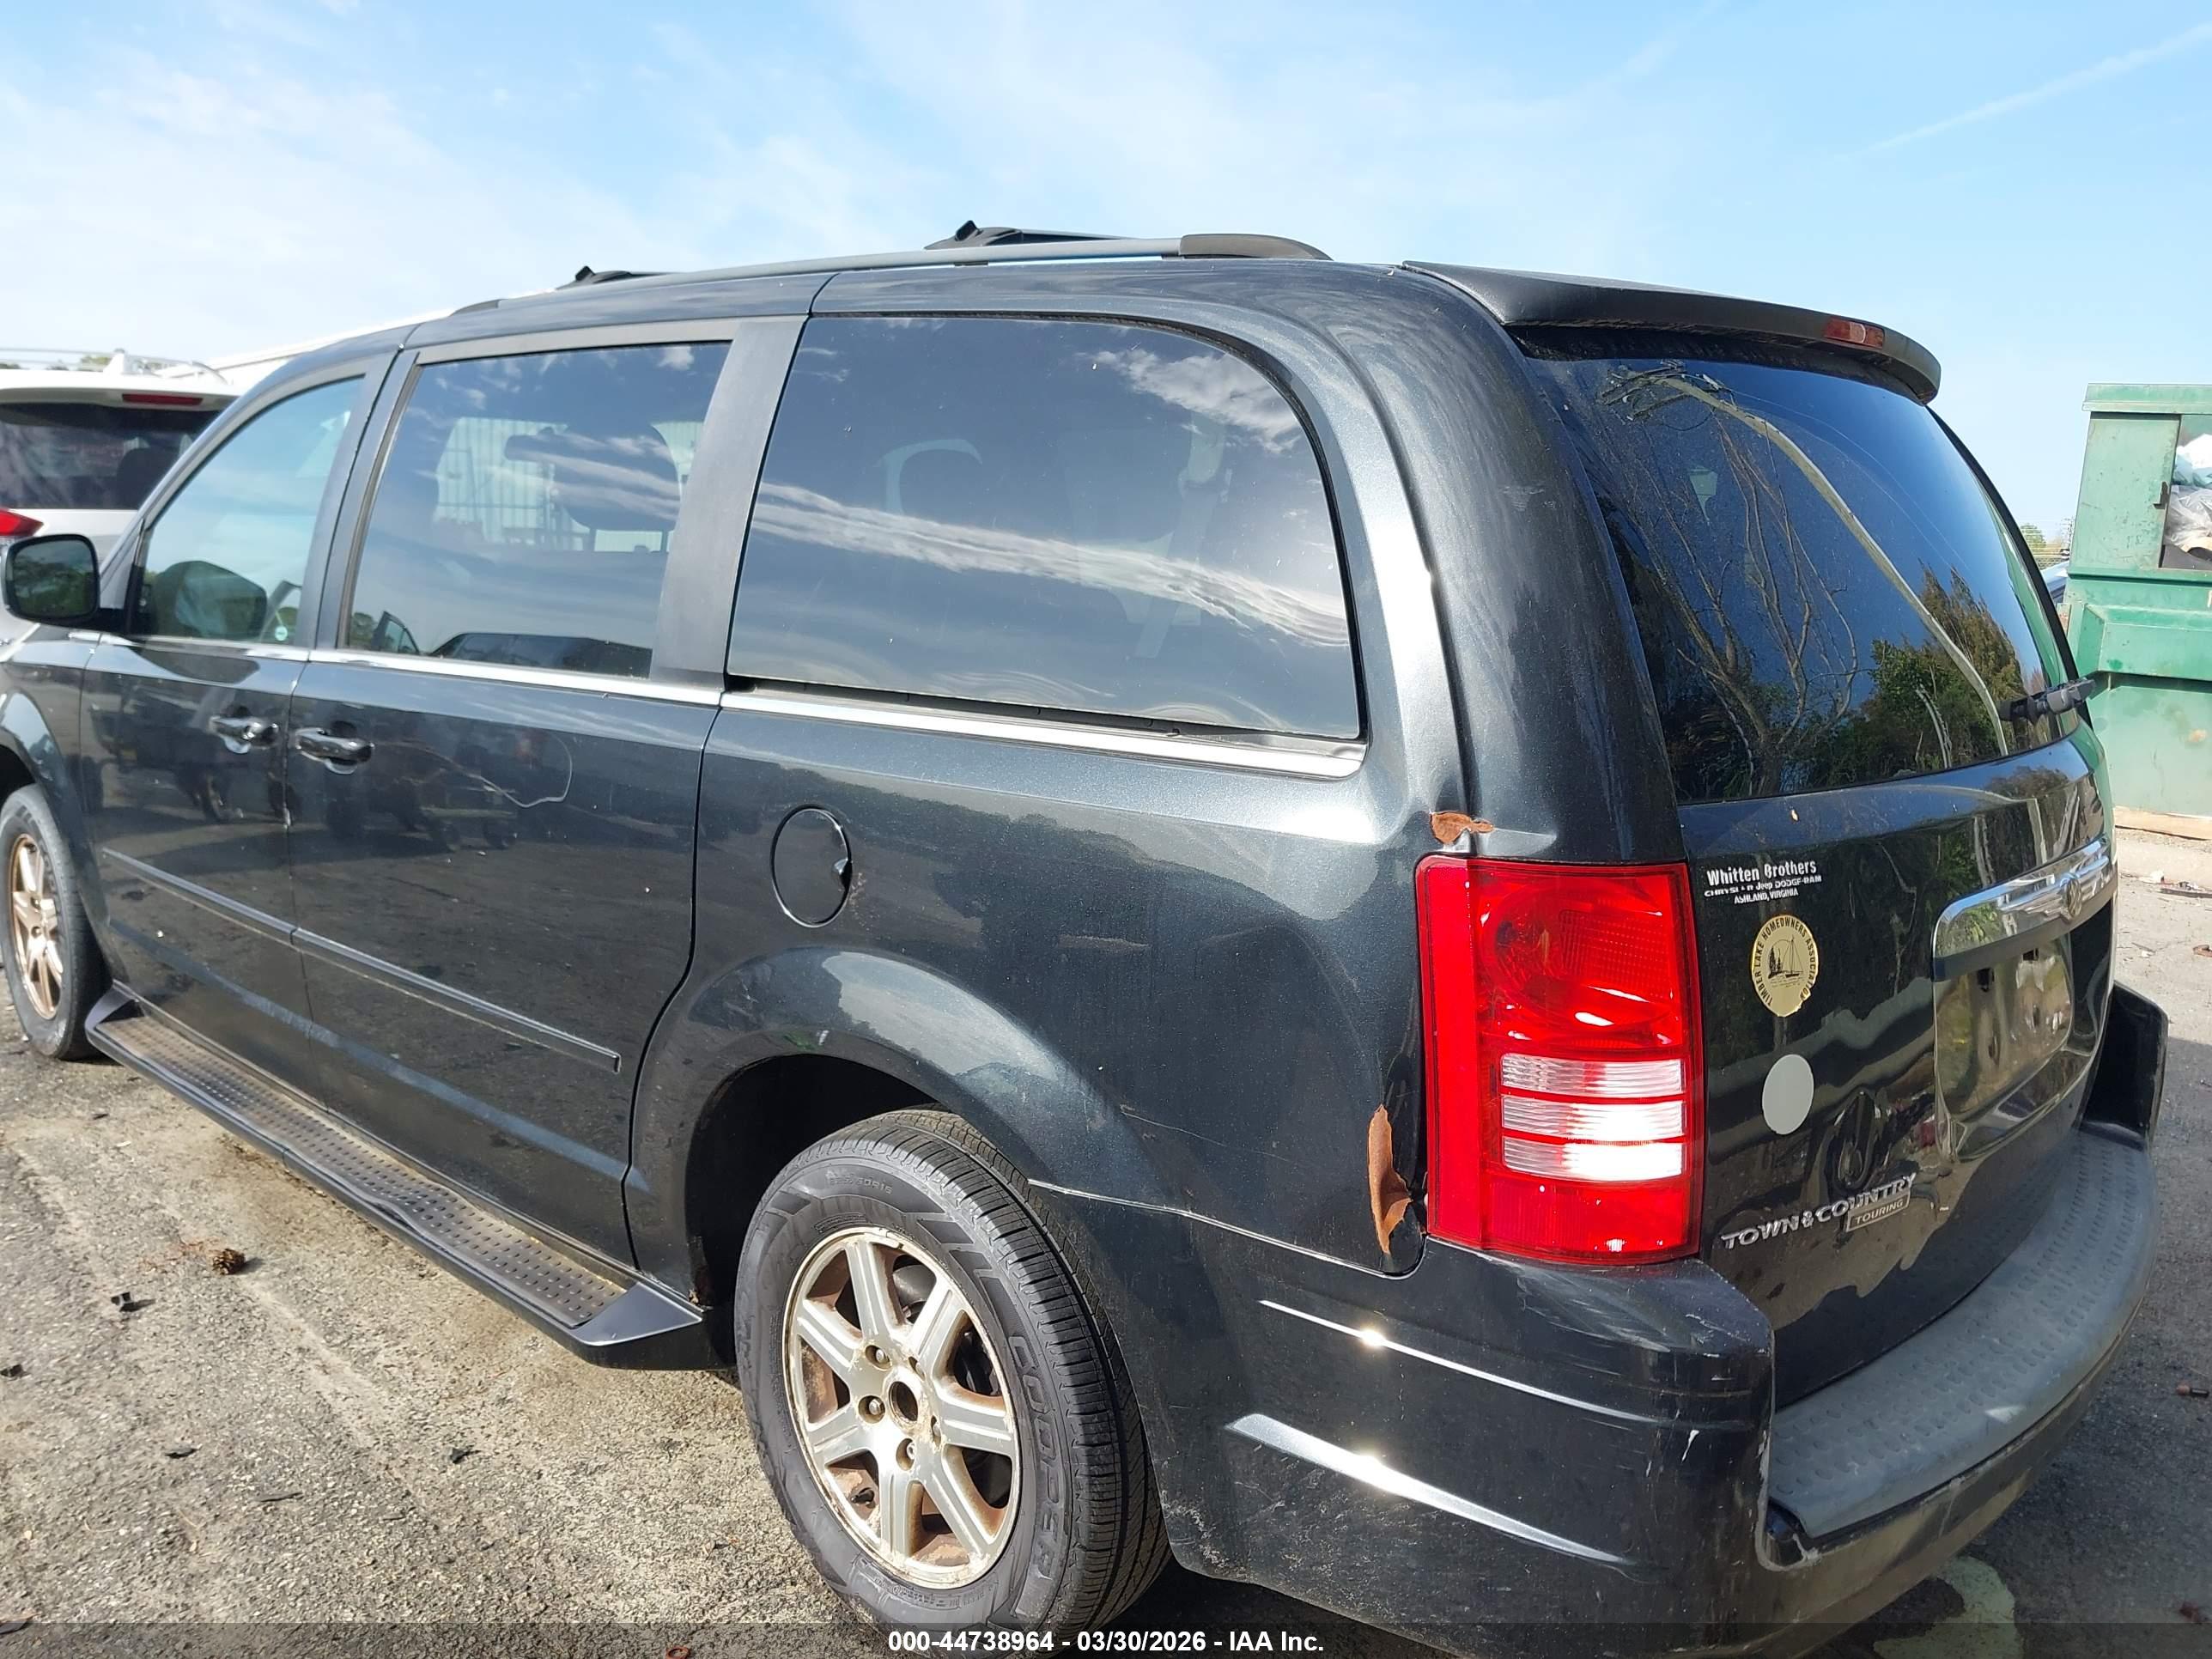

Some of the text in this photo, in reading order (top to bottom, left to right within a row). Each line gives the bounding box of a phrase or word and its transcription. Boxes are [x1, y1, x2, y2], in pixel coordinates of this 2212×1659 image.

[1706, 860, 1817, 886] Whitten Brothers
[1756, 881, 1773, 890] Jeep
[1735, 888, 1799, 904] ASHLAND, VIRGINIA
[1761, 916, 1808, 941] HOMEOWNERS
[1754, 940, 1765, 968] LAKE
[1754, 970, 1773, 1006] TIMBER
[1854, 1198, 1905, 1225] TOURING
[1008, 1335, 1061, 1581] COOPER
